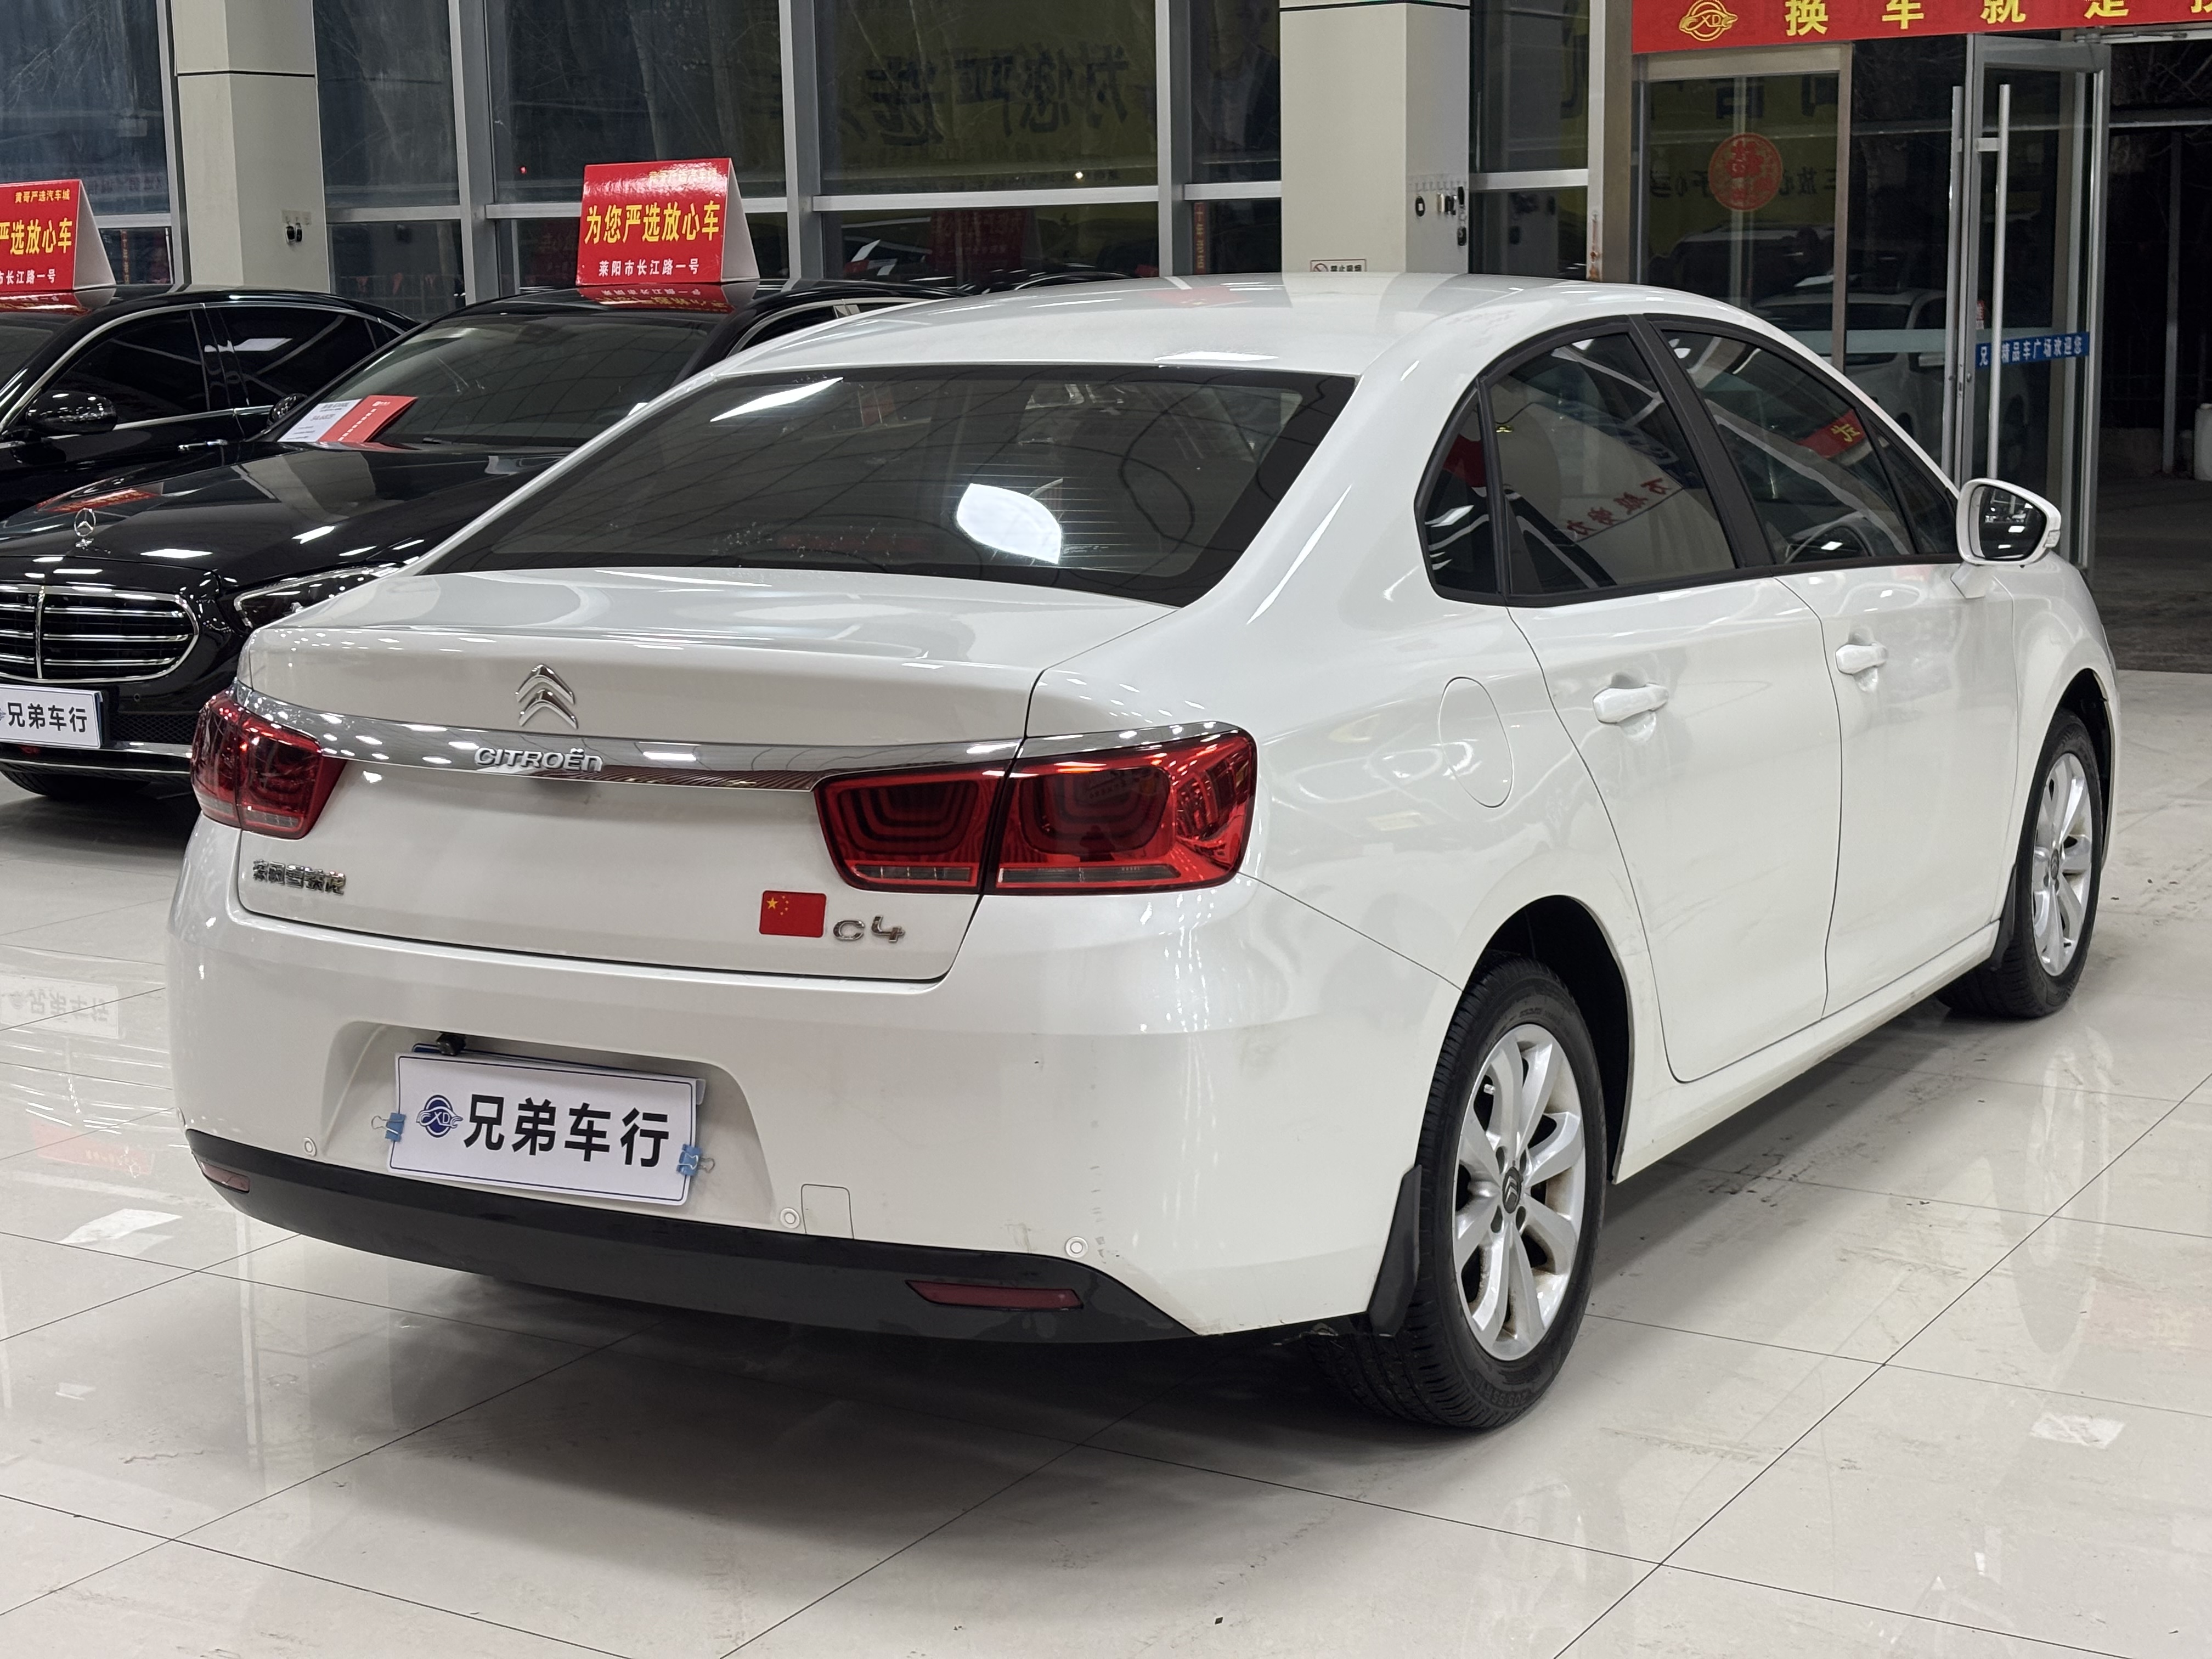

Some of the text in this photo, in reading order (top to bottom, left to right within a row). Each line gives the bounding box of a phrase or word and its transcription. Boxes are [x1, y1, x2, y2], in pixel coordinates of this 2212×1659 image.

[15, 189, 70, 203] 黄哥严选汽车城
[584, 200, 720, 244] 为您严选放心车
[599, 258, 699, 276] 莱阳市长江路一号
[1979, 336, 2083, 366] 兄精品车广场欢迎您
[7, 702, 87, 733] 兄弟车行
[833, 915, 906, 943] C4
[464, 1093, 669, 1167] 兄弟车行
